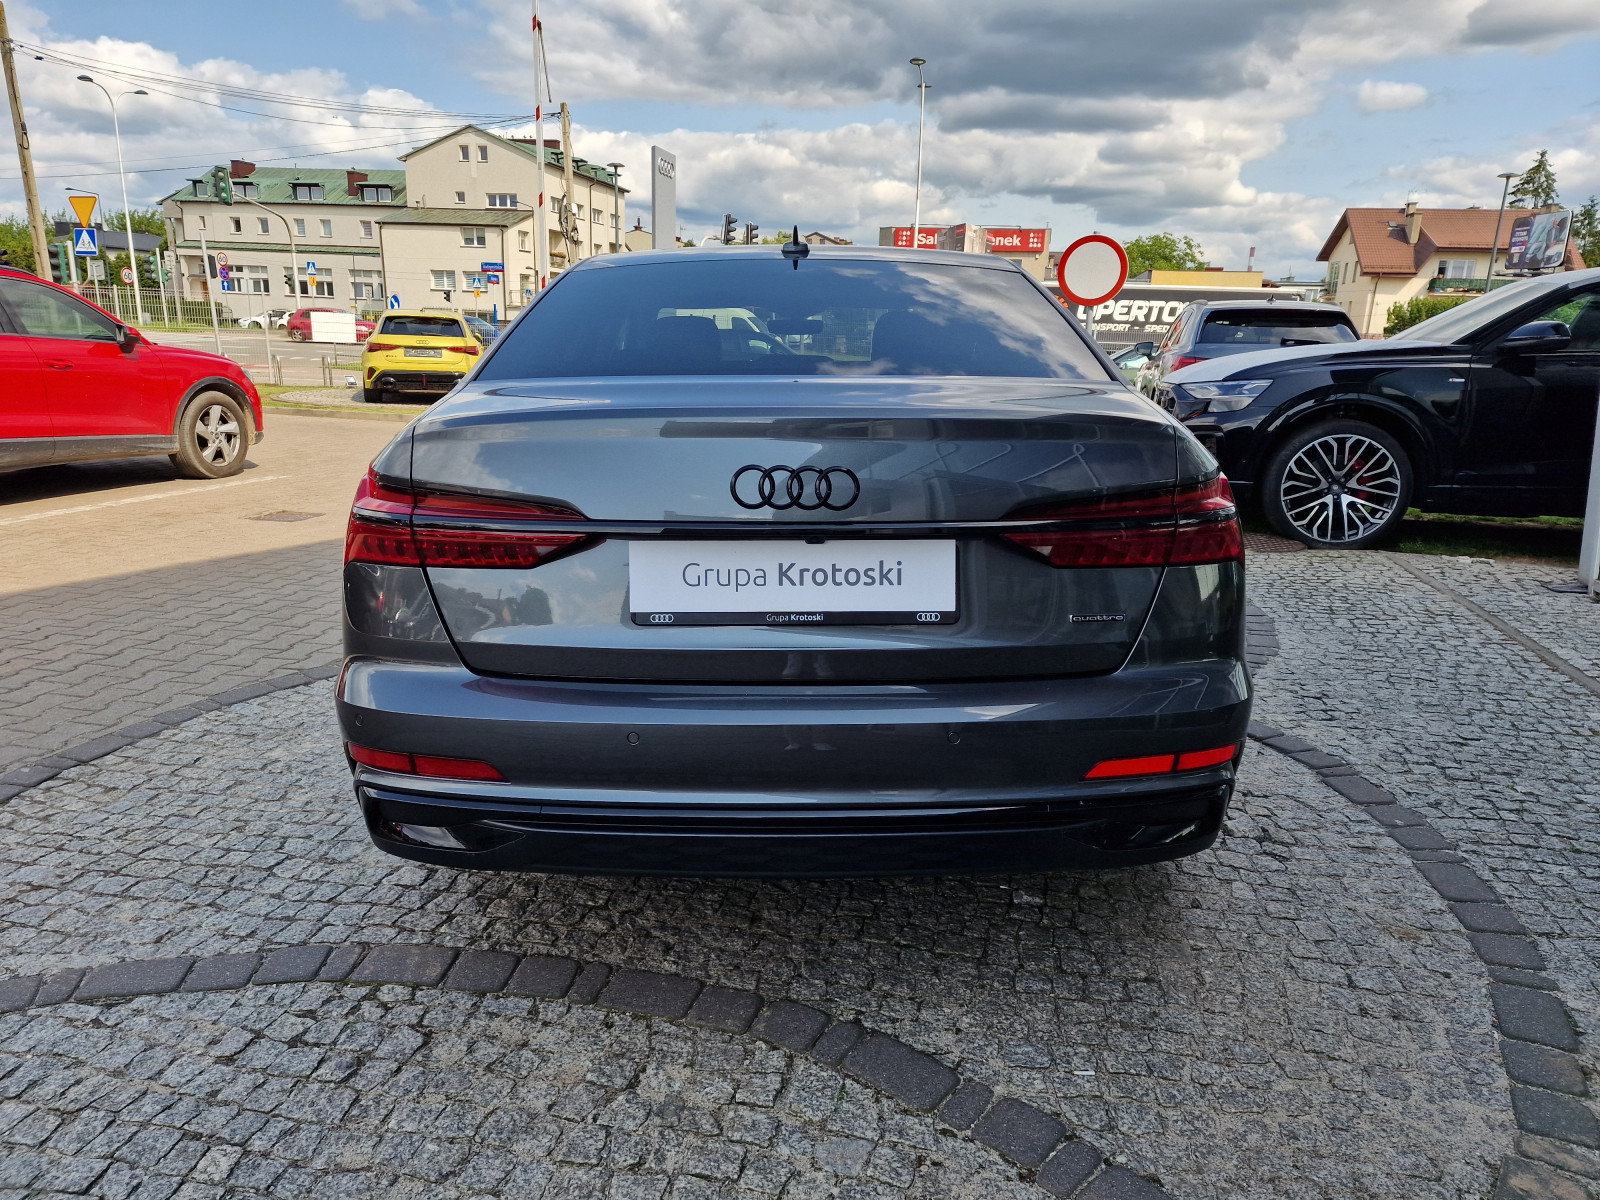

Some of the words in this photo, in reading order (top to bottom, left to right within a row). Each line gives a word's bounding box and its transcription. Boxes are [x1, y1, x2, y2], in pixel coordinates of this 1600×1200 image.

[124, 271, 132, 281] 60
[1076, 299, 1190, 323] PERTO
[682, 562, 767, 593] Grupa
[778, 560, 902, 587] Krotoski
[766, 613, 789, 623] Grupa
[790, 612, 824, 622] Krotoski
